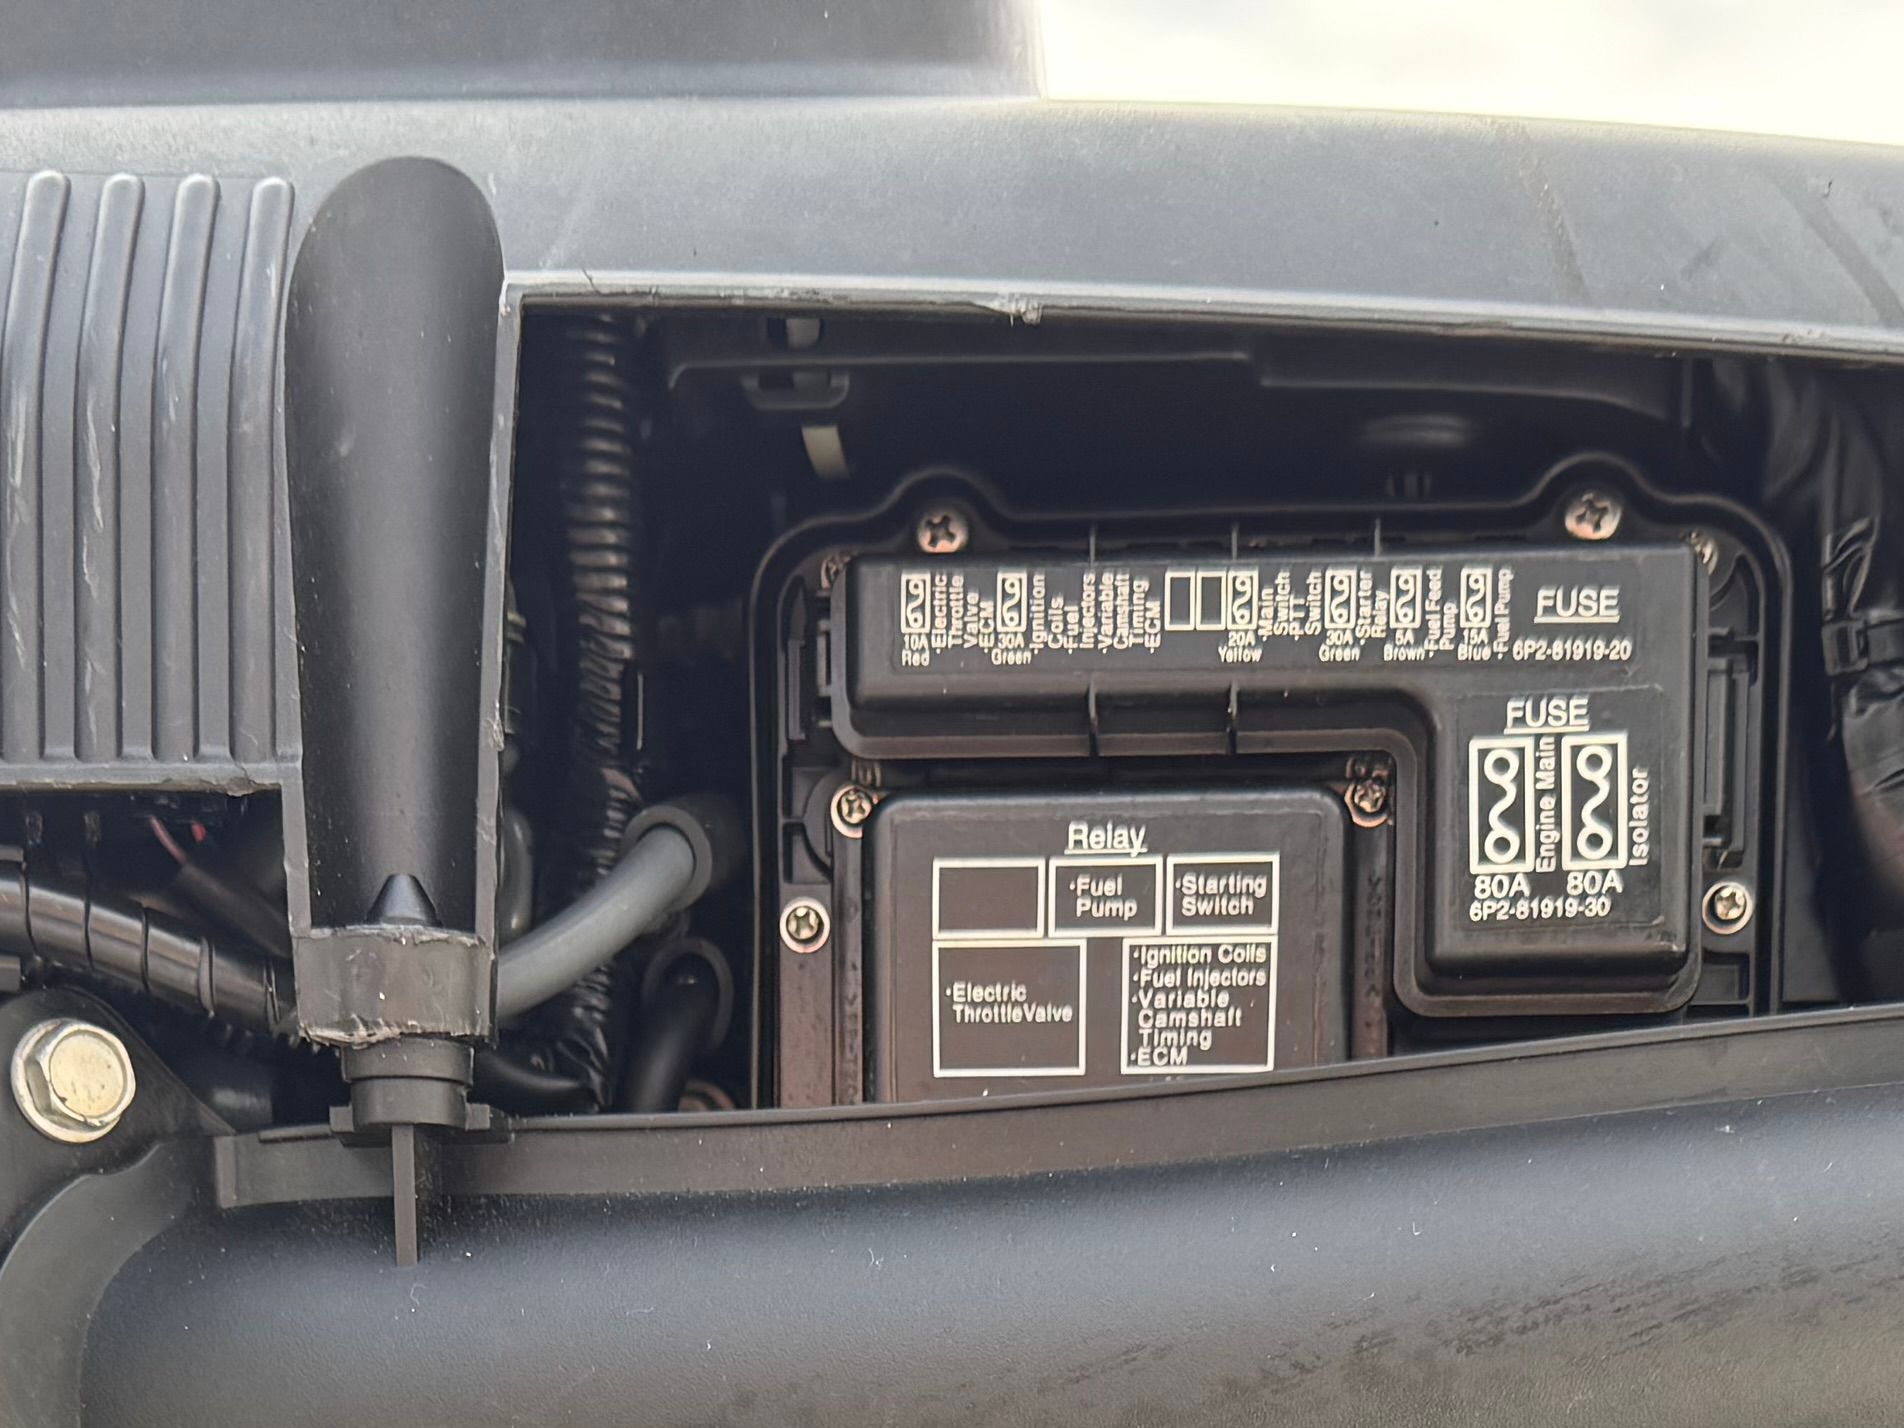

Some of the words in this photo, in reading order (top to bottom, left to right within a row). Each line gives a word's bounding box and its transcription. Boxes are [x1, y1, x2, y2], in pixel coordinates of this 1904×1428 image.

[1274, 570, 1290, 636] Switch
[1305, 569, 1322, 636] Switch
[1357, 568, 1372, 639] Starter
[1425, 569, 1442, 612] Feed
[1494, 567, 1514, 615] Pump
[1537, 587, 1620, 617] FUSE
[932, 571, 946, 648] Electric
[948, 572, 964, 648] Throttle
[964, 590, 979, 648] Valve
[979, 599, 994, 648] ECM
[1030, 572, 1047, 649] Ignition
[1048, 593, 1064, 649] Coils
[1079, 570, 1097, 648] Injectors
[1098, 570, 1114, 649] Variable
[1114, 570, 1130, 649] Camshaft
[1129, 577, 1149, 648] Timing
[1144, 599, 1161, 648] ECM
[1259, 586, 1274, 637] Main
[1371, 588, 1389, 638] Relay
[1064, 604, 1079, 649] Fuel
[1228, 631, 1255, 647] 20A
[1326, 629, 1354, 646] 30A
[1396, 629, 1414, 645] 5A
[1424, 613, 1441, 651] Fuel
[1439, 601, 1457, 651] Pump
[1463, 629, 1489, 646] 15A
[1493, 615, 1510, 653] Fuel
[904, 634, 928, 649] 10A
[991, 648, 1032, 665] Green
[998, 634, 1025, 649] 30A
[1218, 647, 1262, 663] Yellow
[1318, 645, 1360, 662] Green
[1383, 644, 1425, 661] Brown
[1457, 643, 1492, 661] Blue
[1512, 638, 1632, 661] 6P2-81919-20
[902, 650, 930, 666] Red
[1506, 697, 1589, 727] FUSE
[1536, 736, 1555, 790] Main
[1629, 766, 1649, 866] Isolator
[1068, 822, 1147, 857] Relay
[1536, 795, 1560, 873] Engine
[1076, 874, 1122, 896] Fuel
[1181, 872, 1267, 897] Starting
[1474, 873, 1531, 899] 80A
[1567, 869, 1623, 896] 80A
[1076, 898, 1137, 920] Pump
[1181, 896, 1254, 916] Switch
[1469, 897, 1612, 921] 6P2-81919-30
[1140, 945, 1212, 967] Ignition
[1217, 944, 1267, 964] Coils
[952, 982, 1027, 1002] Electric
[1140, 968, 1181, 987] Fuel
[1187, 967, 1266, 988] Injectors
[1138, 990, 1230, 1008] Variable
[1138, 1008, 1242, 1028] Camshaft
[1139, 1028, 1212, 1050] Timing
[1138, 1049, 1188, 1066] ECM
